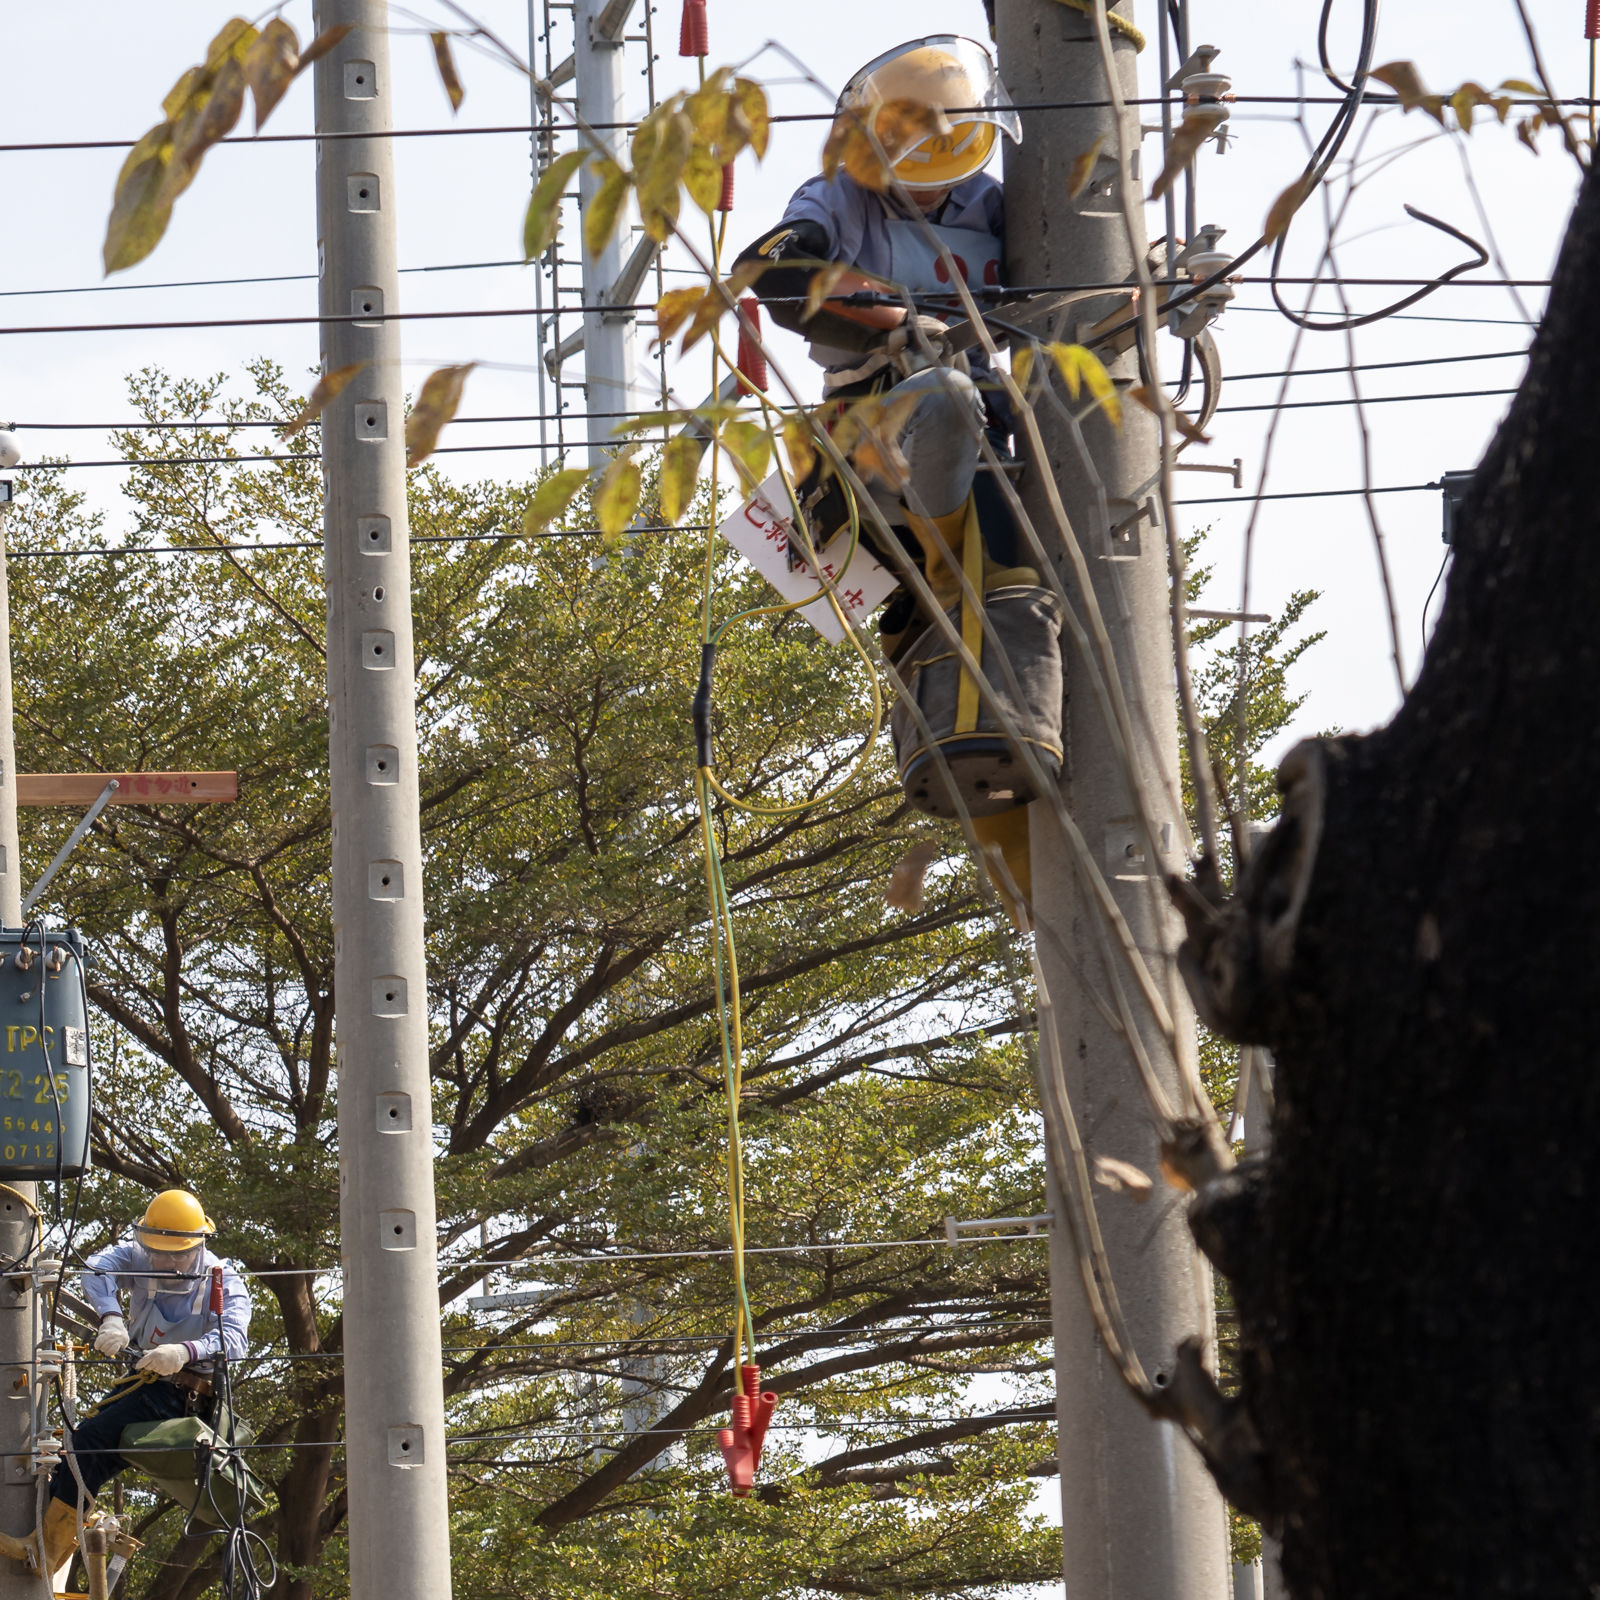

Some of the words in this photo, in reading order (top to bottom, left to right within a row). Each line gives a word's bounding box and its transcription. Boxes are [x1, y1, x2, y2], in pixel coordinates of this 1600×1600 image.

[744, 498, 865, 622] 已剝外皮
[5, 1025, 56, 1053] TPC
